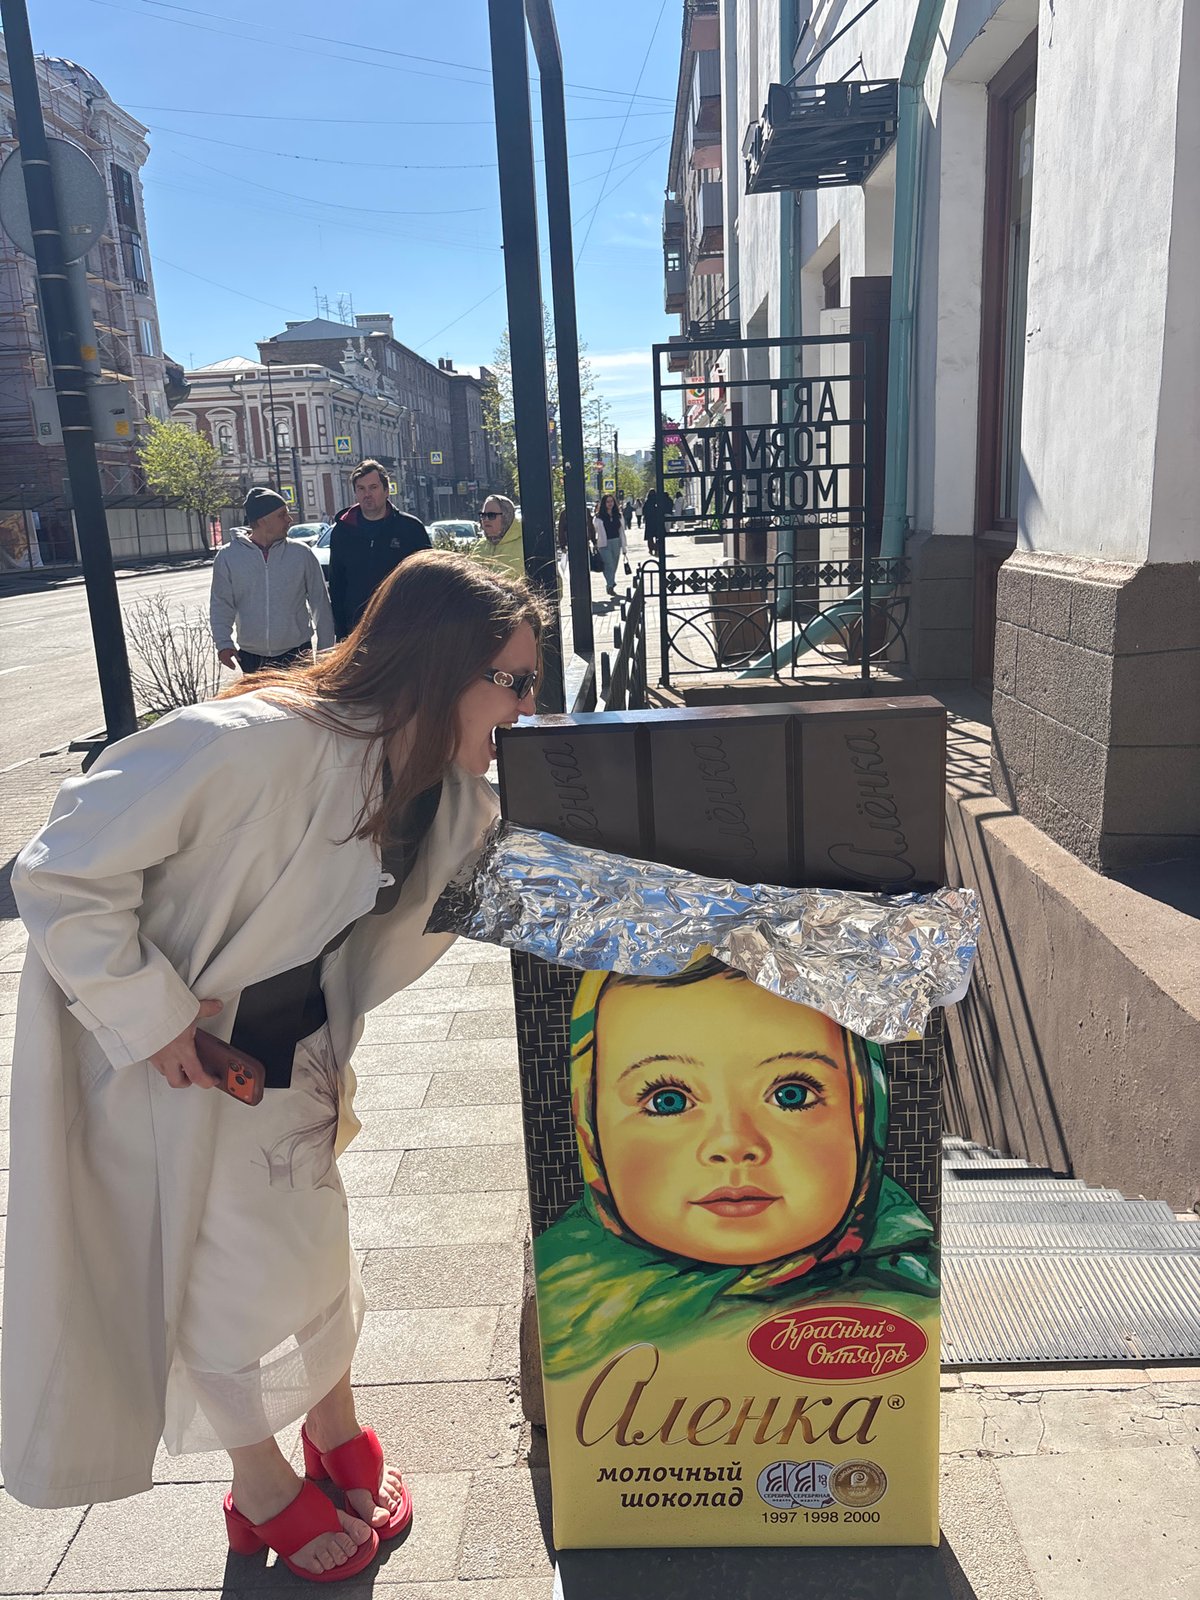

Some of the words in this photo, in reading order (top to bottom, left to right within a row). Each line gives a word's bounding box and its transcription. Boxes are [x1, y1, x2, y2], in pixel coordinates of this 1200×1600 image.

[827, 727, 916, 884] Алёнка
[770, 1316, 887, 1350] Красный
[807, 1342, 910, 1375] Октябрь
[596, 1460, 742, 1484] молочный
[620, 1487, 744, 1508] шоколад
[762, 1511, 797, 1523] 1997
[803, 1511, 839, 1523] 1998
[843, 1511, 881, 1523] 2000
